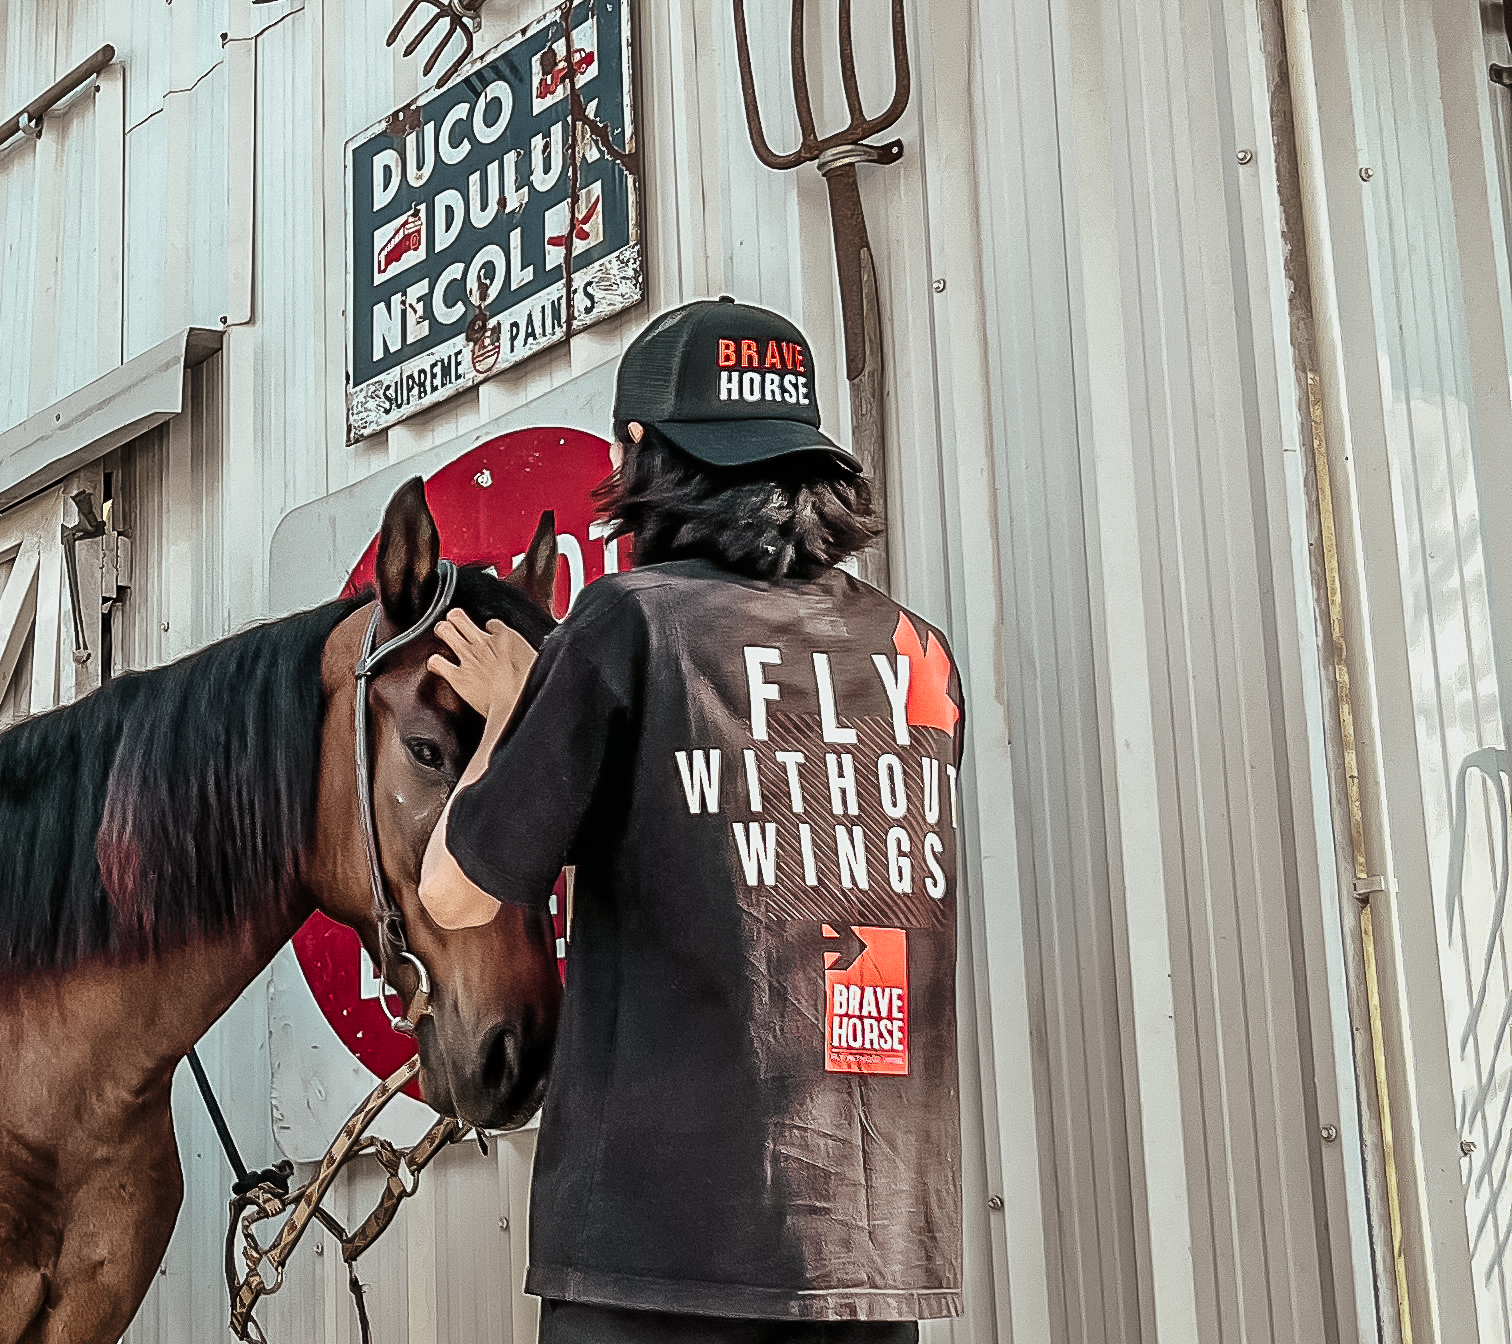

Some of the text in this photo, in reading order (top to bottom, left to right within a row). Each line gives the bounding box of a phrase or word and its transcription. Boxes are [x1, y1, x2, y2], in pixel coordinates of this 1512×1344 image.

[372, 80, 513, 212] DUCO
[372, 226, 534, 362] NECOL
[382, 349, 464, 416] SUPREME
[718, 338, 806, 372] BRAVE
[719, 371, 809, 405] HORSE
[743, 646, 911, 747] FLY
[674, 748, 958, 829] WITHOUT
[732, 822, 947, 900] WINGS
[831, 1016, 905, 1051] HORSE
[833, 983, 904, 1018] BRAVE
